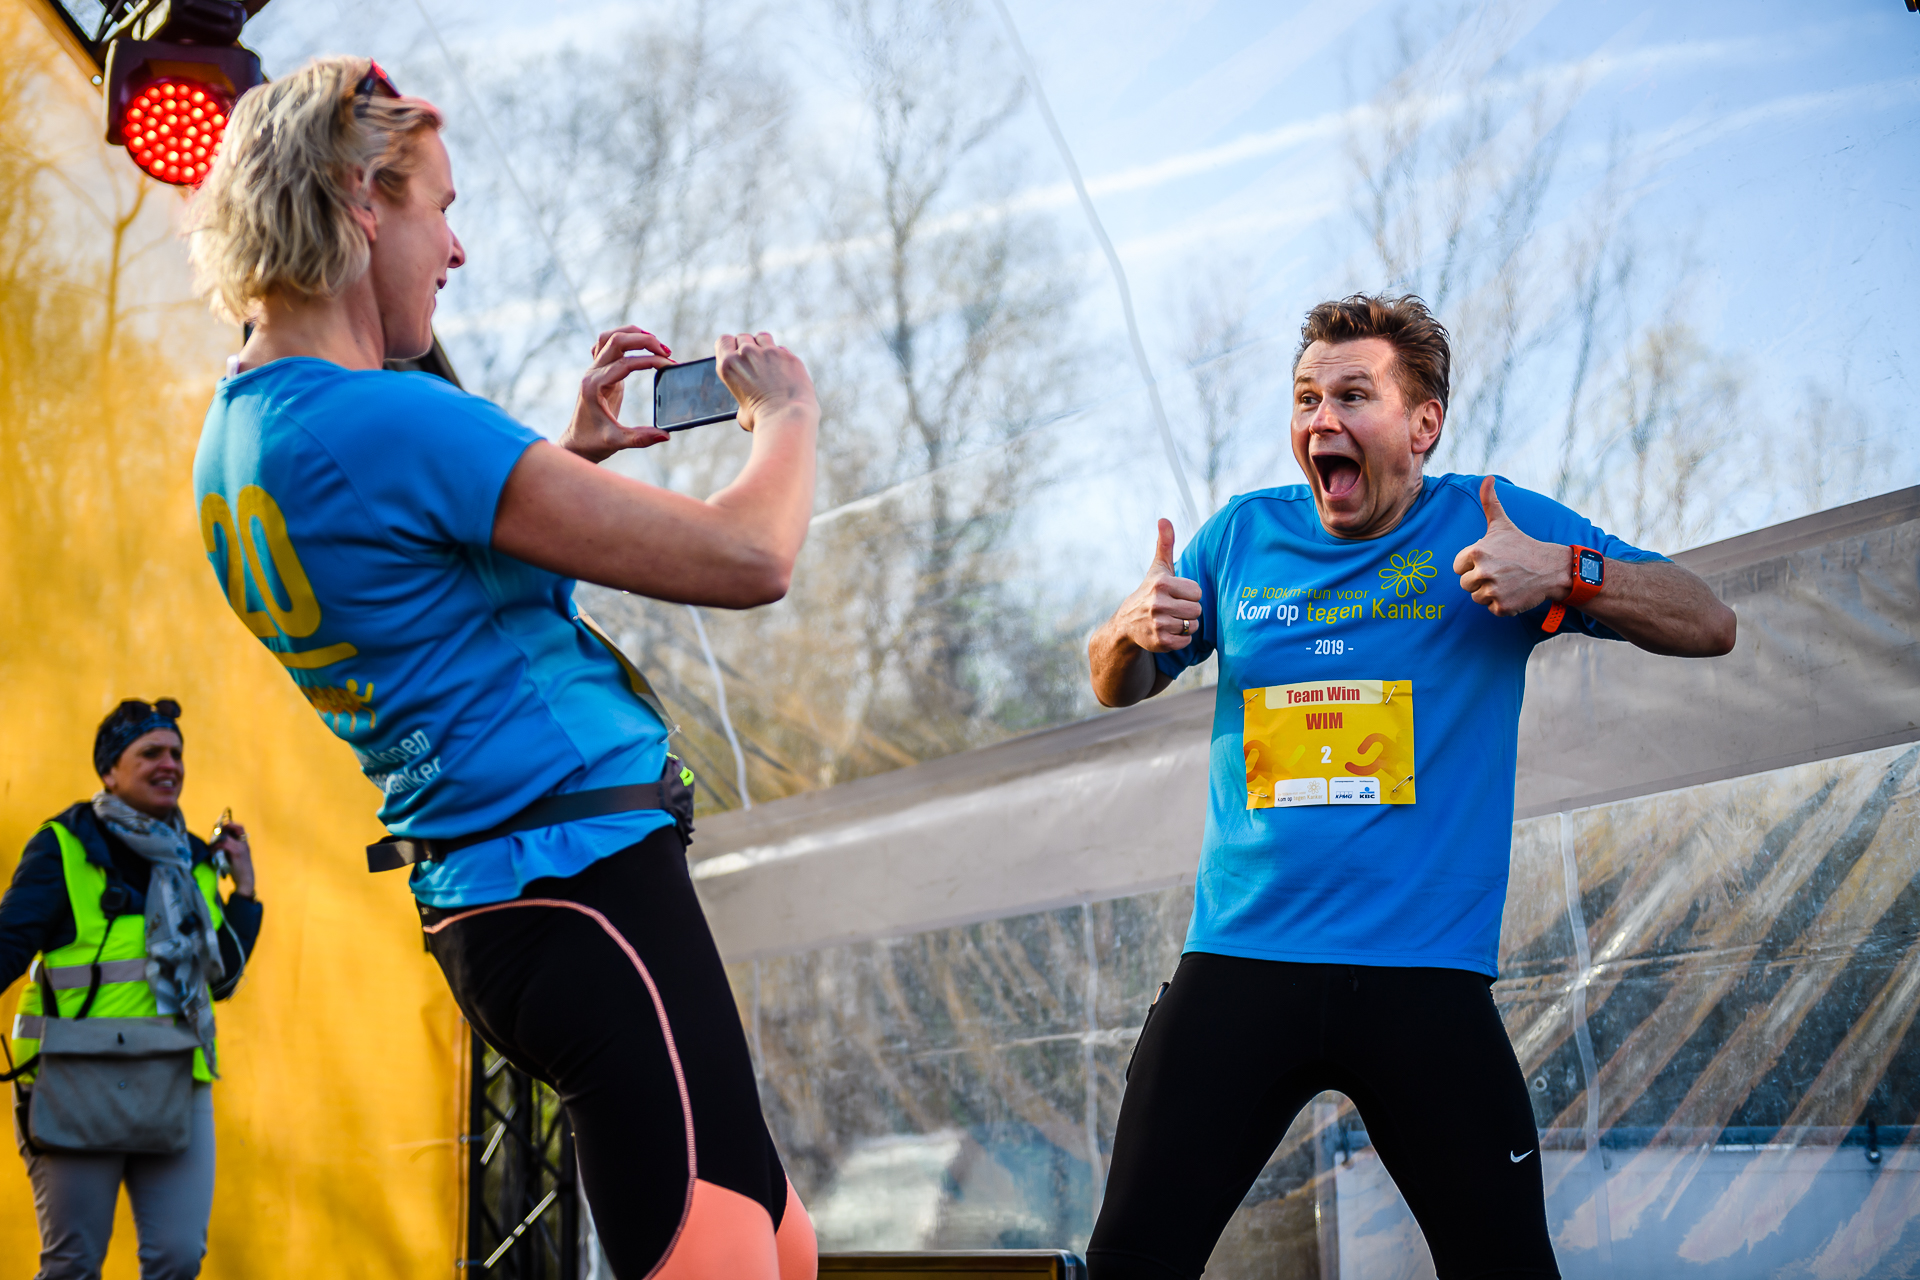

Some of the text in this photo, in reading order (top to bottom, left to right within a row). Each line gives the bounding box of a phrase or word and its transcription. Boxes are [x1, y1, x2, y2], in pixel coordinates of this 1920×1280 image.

[1241, 587, 1370, 600] De 100km-run voor
[1236, 598, 1445, 627] Kom op tegen Kanker
[1314, 639, 1344, 655] 2019
[1286, 686, 1361, 704] Team Wim
[1305, 712, 1343, 730] WIM
[1320, 745, 1332, 764] 2
